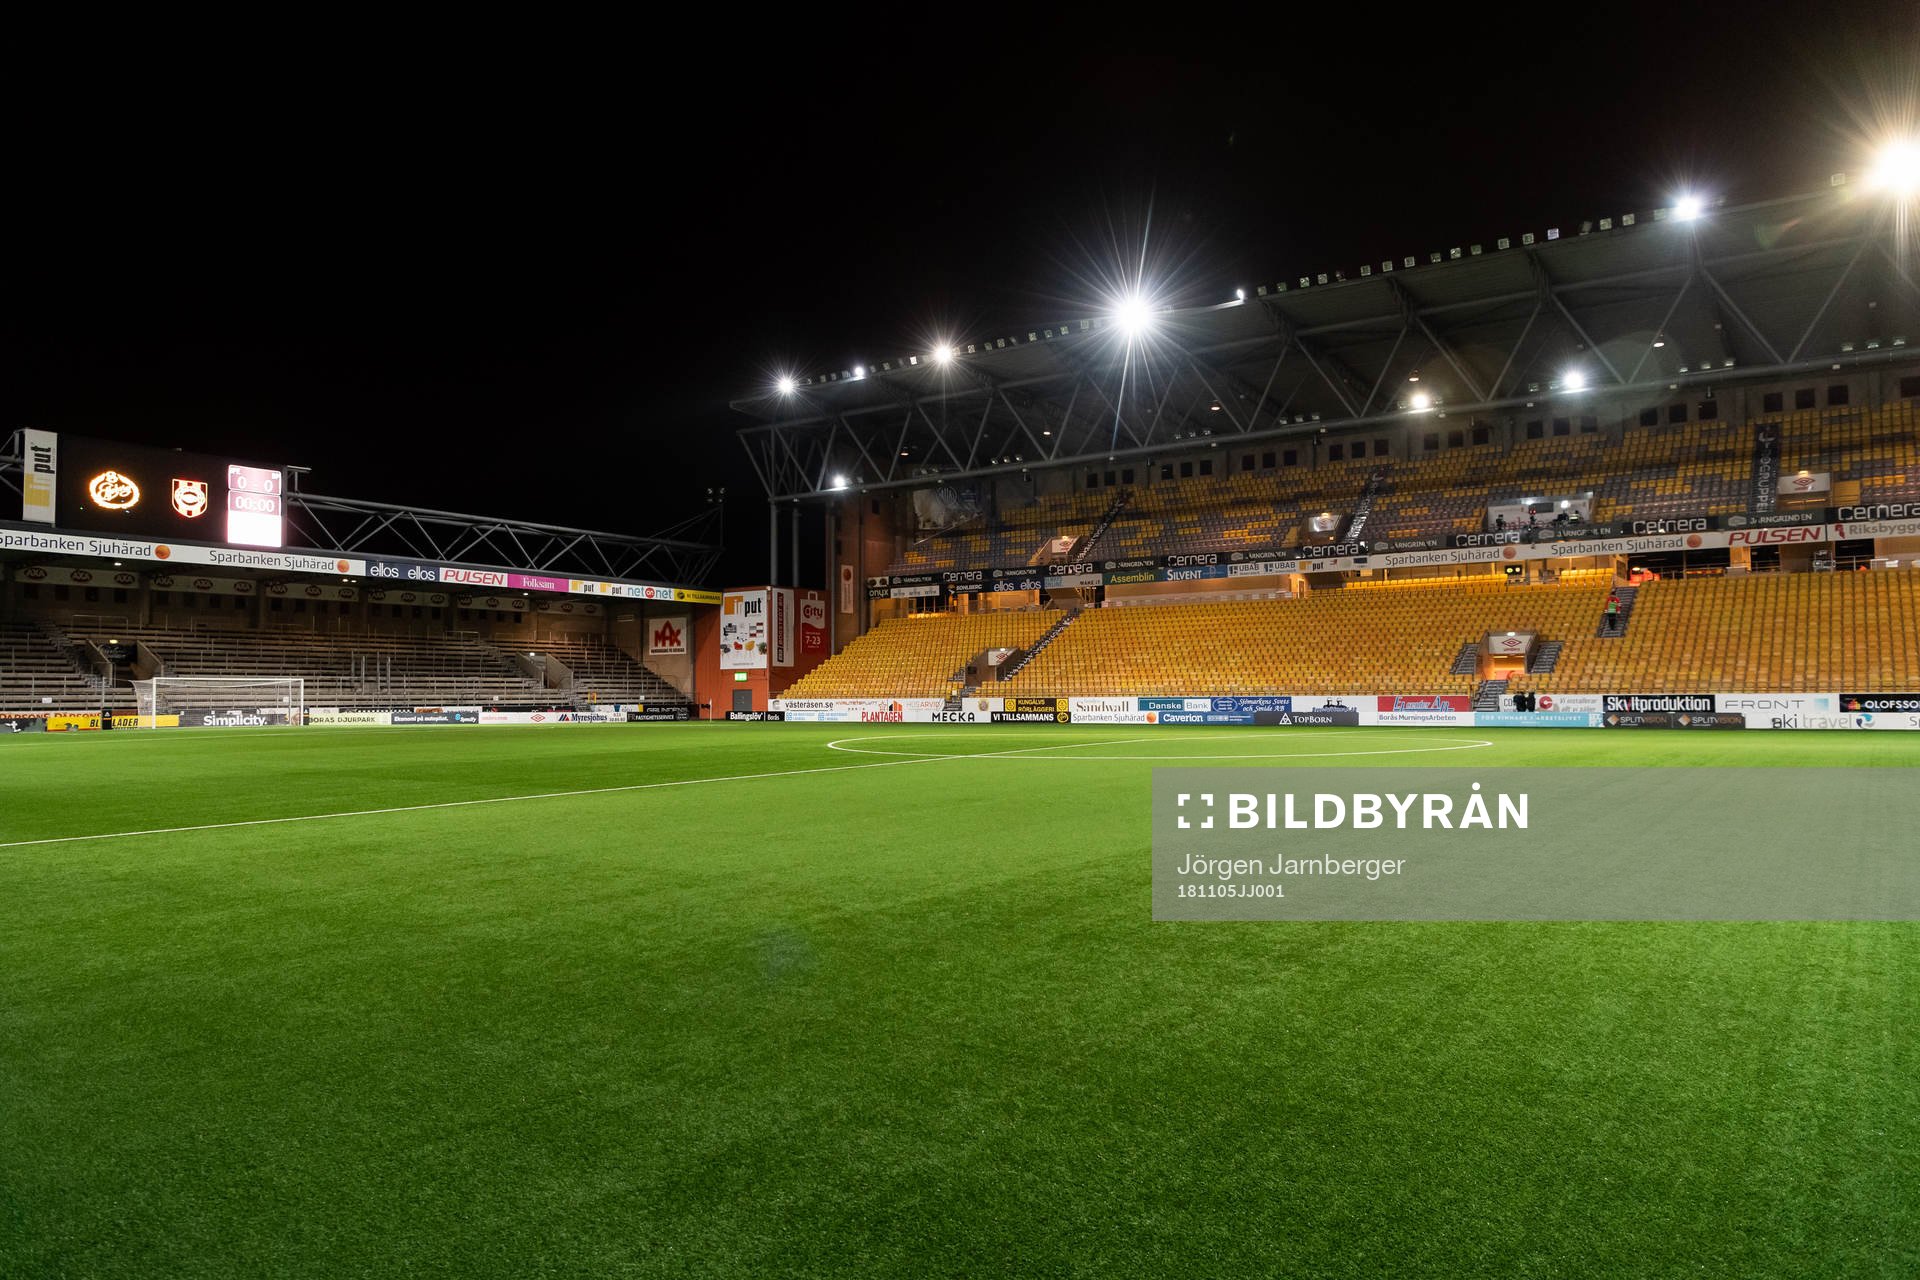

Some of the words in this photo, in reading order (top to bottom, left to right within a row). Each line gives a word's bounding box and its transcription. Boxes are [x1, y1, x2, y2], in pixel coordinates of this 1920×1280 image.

[31, 446, 55, 474] put
[1728, 527, 1820, 546] PULSEN
[90, 540, 150, 556] Sjuhärad
[1552, 541, 1622, 556] Sparbanken
[1627, 537, 1683, 552] Sjuhärad
[210, 550, 281, 566] Sparbanken
[284, 556, 334, 570] Sjuhärad
[1386, 551, 1448, 566] Sparbanken
[1450, 548, 1500, 564] Sjuhärad
[370, 562, 400, 578] ellos
[408, 566, 436, 580] ellos
[1239, 564, 1260, 572] UBAB
[1312, 562, 1324, 571] put
[26, 570, 46, 578] AXA
[72, 572, 91, 580] AXA
[444, 570, 504, 585] PULSEN
[1110, 573, 1154, 584] Assemblin
[1167, 569, 1202, 581] SILVENT
[522, 578, 554, 590] Folksam
[584, 583, 594, 594] put
[612, 584, 622, 595] put
[994, 580, 1014, 592] ellos
[868, 589, 888, 597] onyx
[744, 598, 762, 618] put
[804, 604, 822, 618] City
[654, 620, 681, 647] MAX
[805, 636, 820, 644] 7-23
[1076, 701, 1129, 712] Sandwall
[1148, 702, 1182, 710] Danske
[1608, 696, 1710, 712] Skyltproduktion
[1724, 700, 1804, 710] FRONT
[1864, 700, 1920, 709] OLOFSSO
[862, 712, 902, 723] PLANTAGEN
[932, 712, 975, 722] MECKA
[1002, 713, 1054, 722] TILLSAMMANS
[1074, 714, 1112, 722] Sparbanken
[1114, 712, 1144, 722] Sjuhärad
[1163, 713, 1203, 722] Caverion
[1379, 714, 1398, 722] Borås
[1692, 716, 1742, 724] SPLITVISION
[1802, 713, 1853, 728] travel
